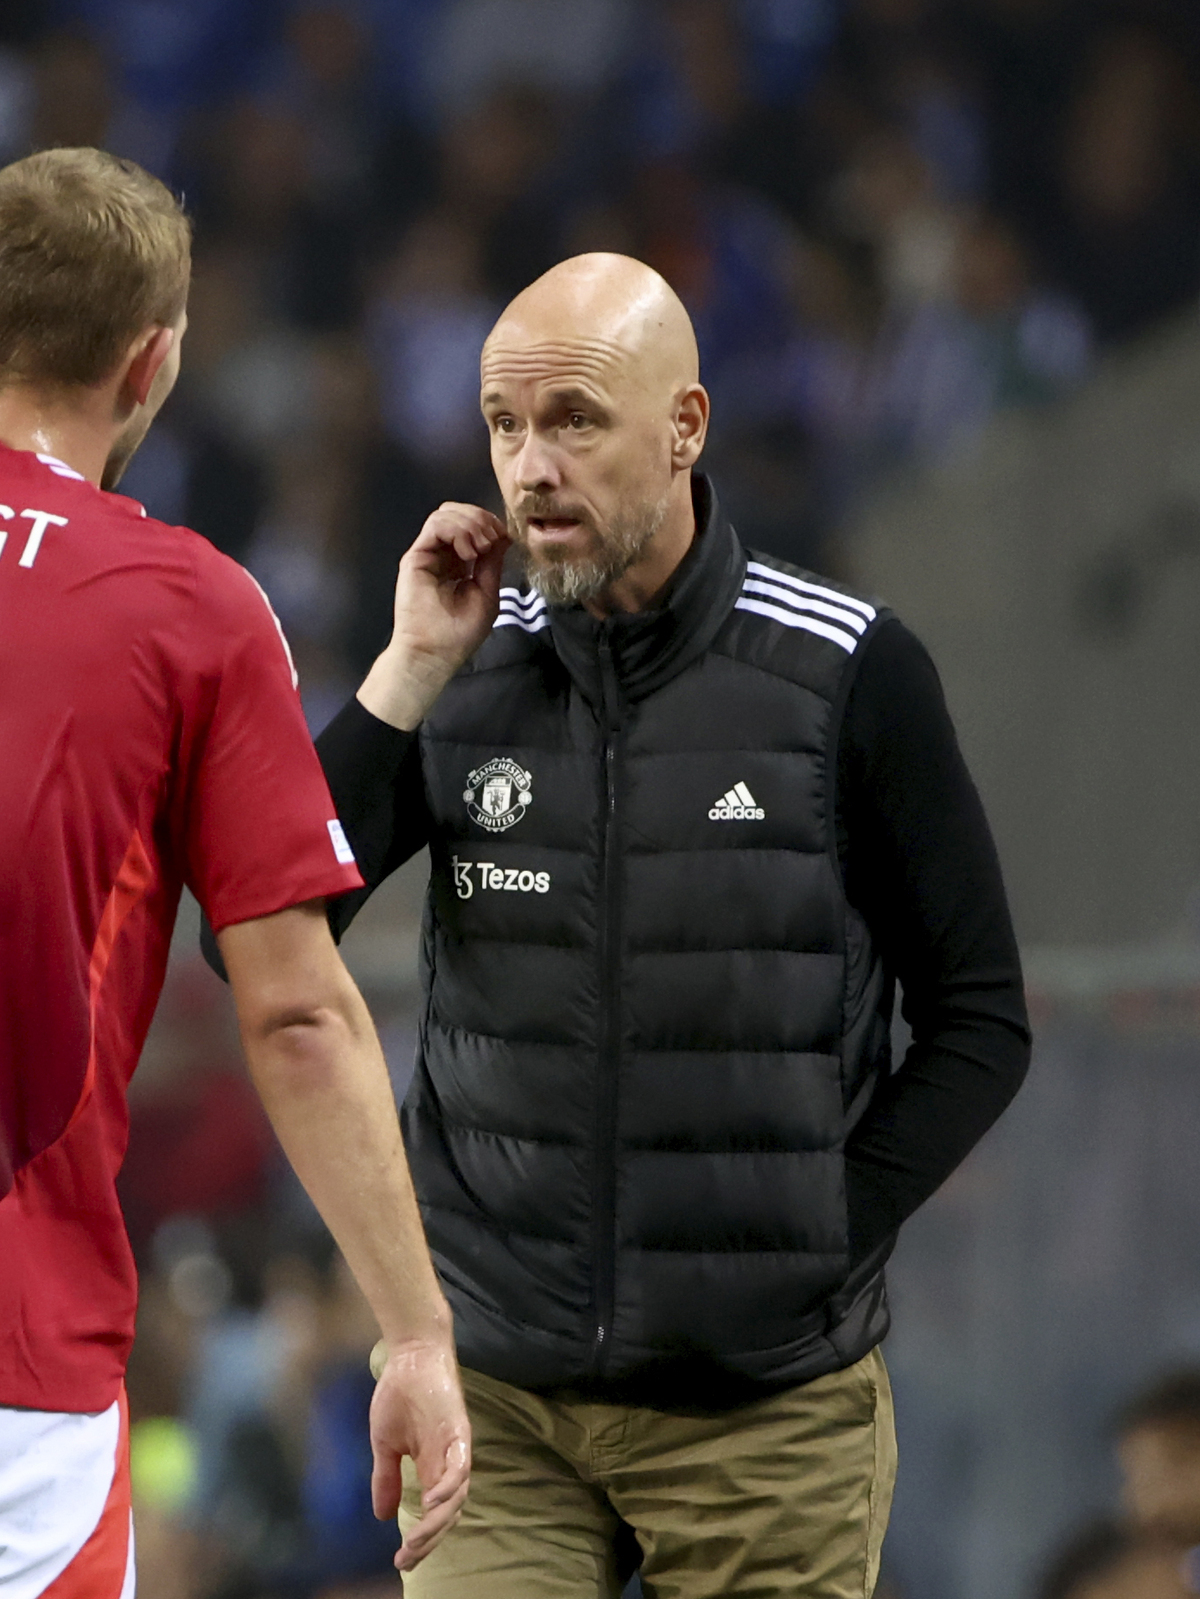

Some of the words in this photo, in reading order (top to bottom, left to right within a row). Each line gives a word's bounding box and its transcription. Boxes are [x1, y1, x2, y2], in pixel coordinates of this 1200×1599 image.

[471, 761, 528, 788] MANCHESTER
[476, 813, 516, 828] UNITED
[708, 804, 766, 821] adidas
[476, 862, 551, 894] Tezos
